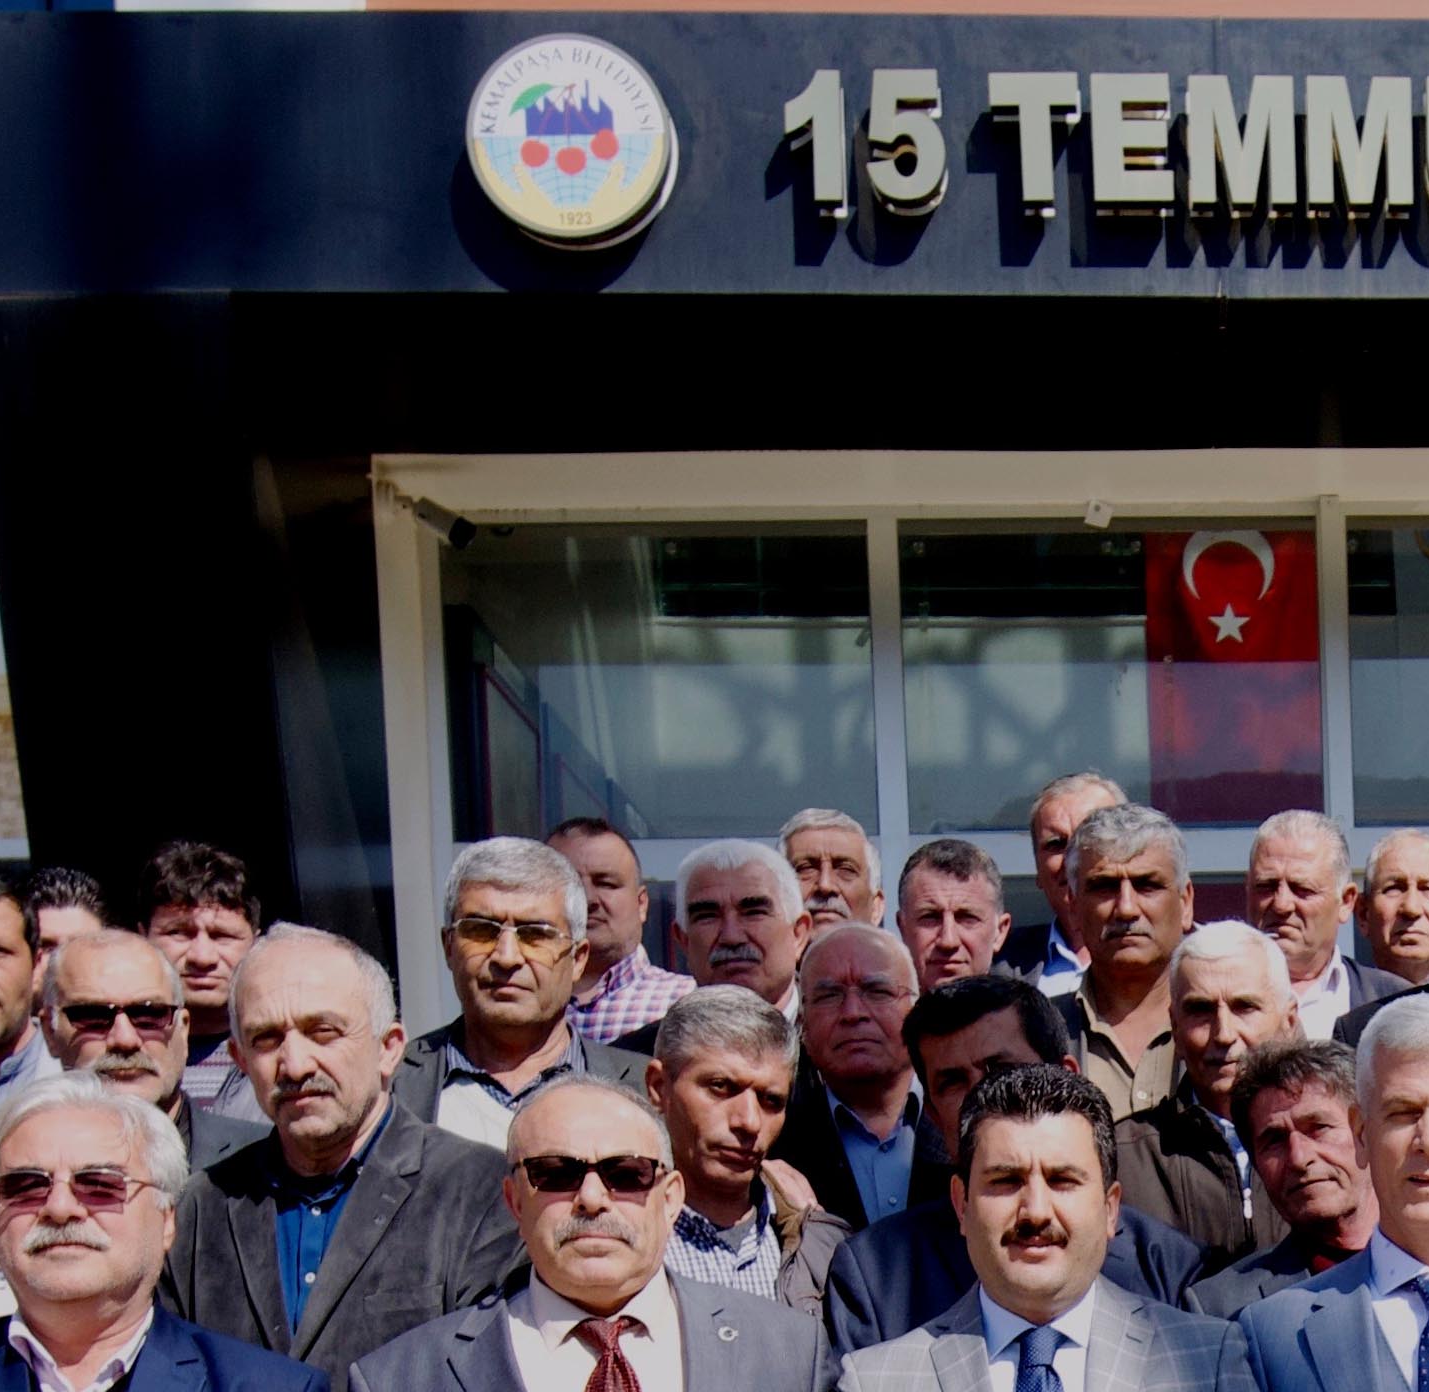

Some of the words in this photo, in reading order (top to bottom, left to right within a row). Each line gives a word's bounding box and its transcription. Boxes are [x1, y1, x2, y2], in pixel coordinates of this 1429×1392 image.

[480, 47, 564, 134] KEMALPAŞA
[784, 68, 947, 203] 15
[559, 211, 593, 225] 1923
